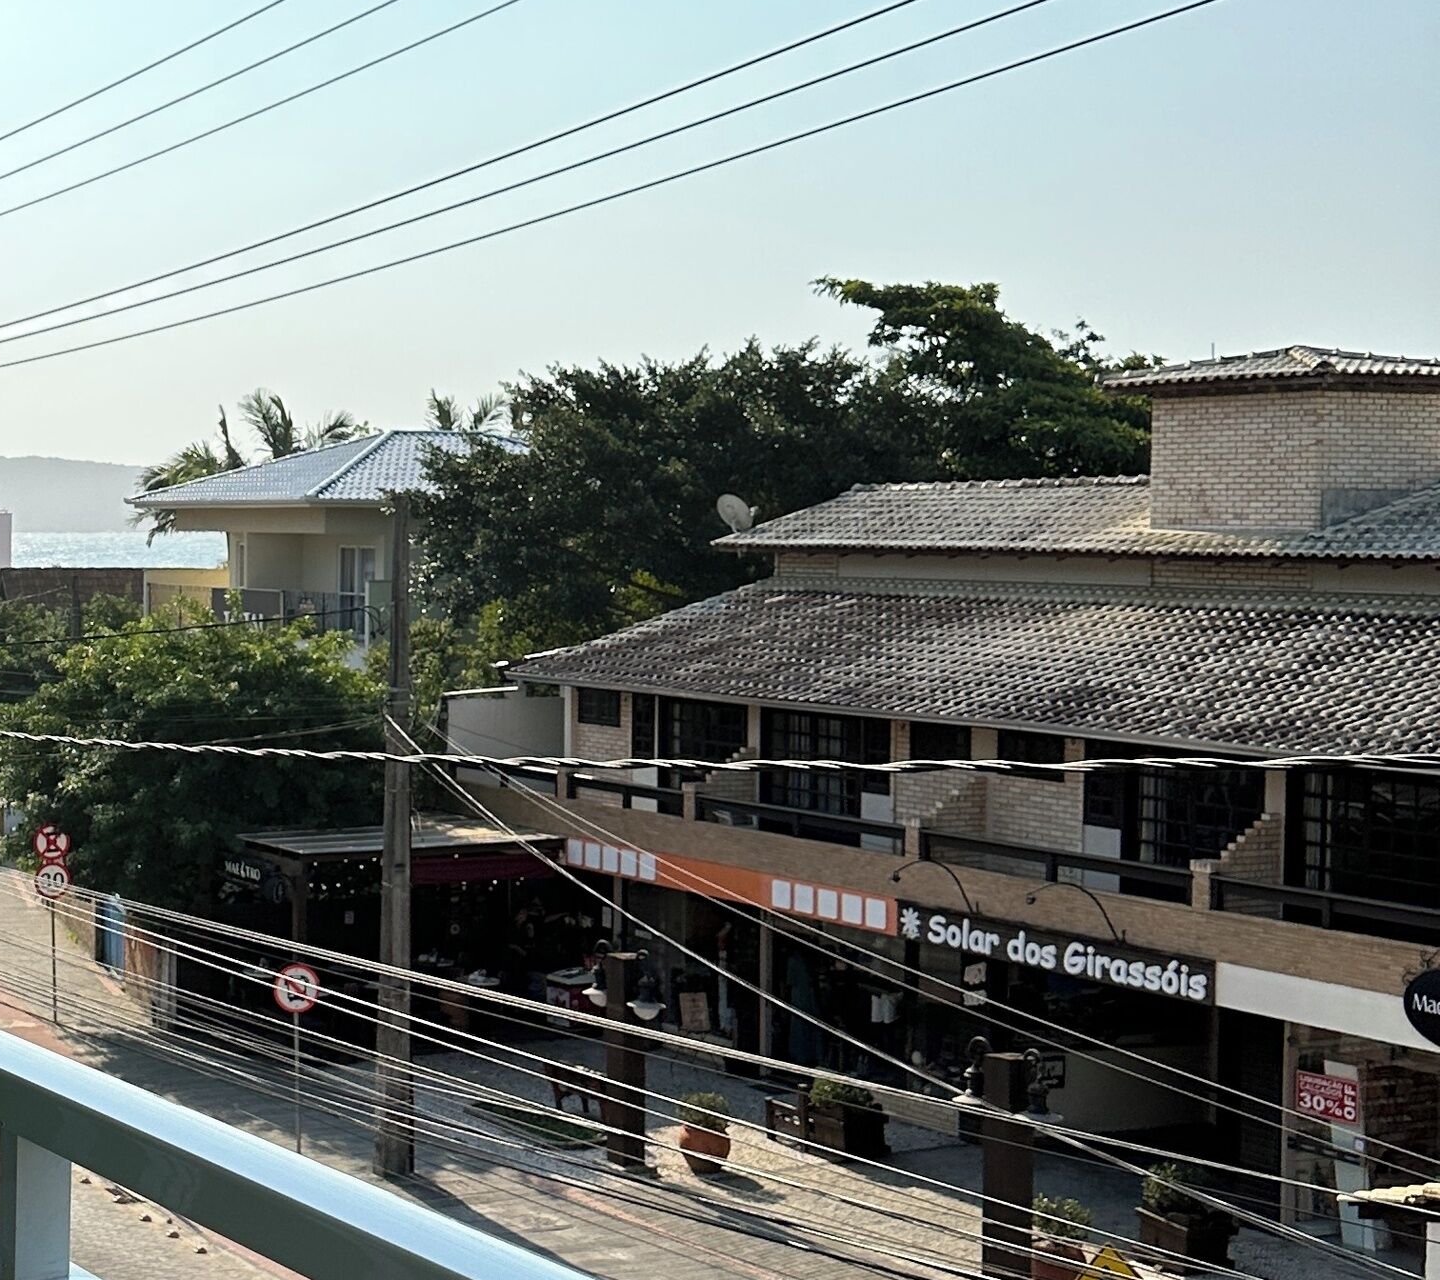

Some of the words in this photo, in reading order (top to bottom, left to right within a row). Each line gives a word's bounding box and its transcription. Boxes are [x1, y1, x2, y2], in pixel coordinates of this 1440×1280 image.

[927, 914, 1000, 956] Solar
[1006, 930, 1058, 970] dos
[1063, 941, 1208, 1001] Girassóis
[1299, 1091, 1343, 1117] 30%
[1343, 1083, 1356, 1121] OFF
